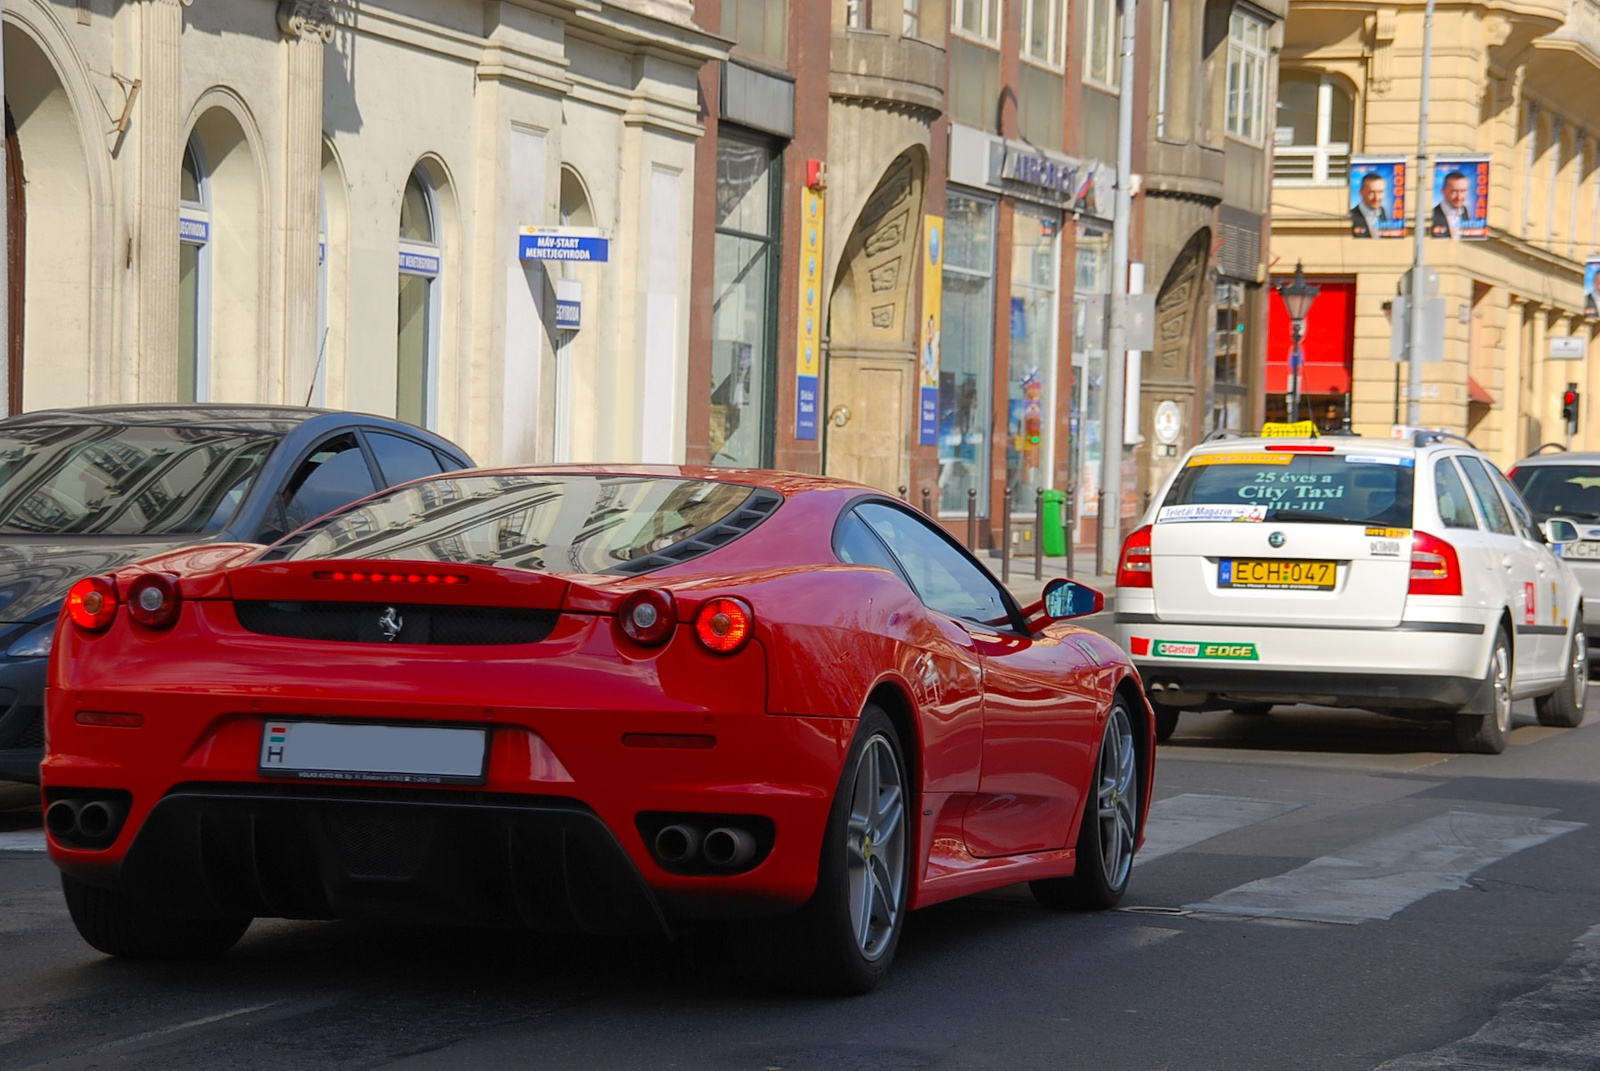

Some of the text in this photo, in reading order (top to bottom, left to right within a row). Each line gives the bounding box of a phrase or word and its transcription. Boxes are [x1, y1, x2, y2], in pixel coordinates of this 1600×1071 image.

[537, 236, 580, 249] MÁV-START
[525, 247, 591, 260] MENETJEGYIRODA
[1254, 472, 1332, 483] 25 éves a
[1238, 485, 1345, 501] City Taxi
[1165, 507, 1233, 517] Teletál Magazin
[1236, 562, 1330, 582] ECH-047
[1167, 645, 1254, 657] Castrol EDGE
[266, 746, 284, 763] H
